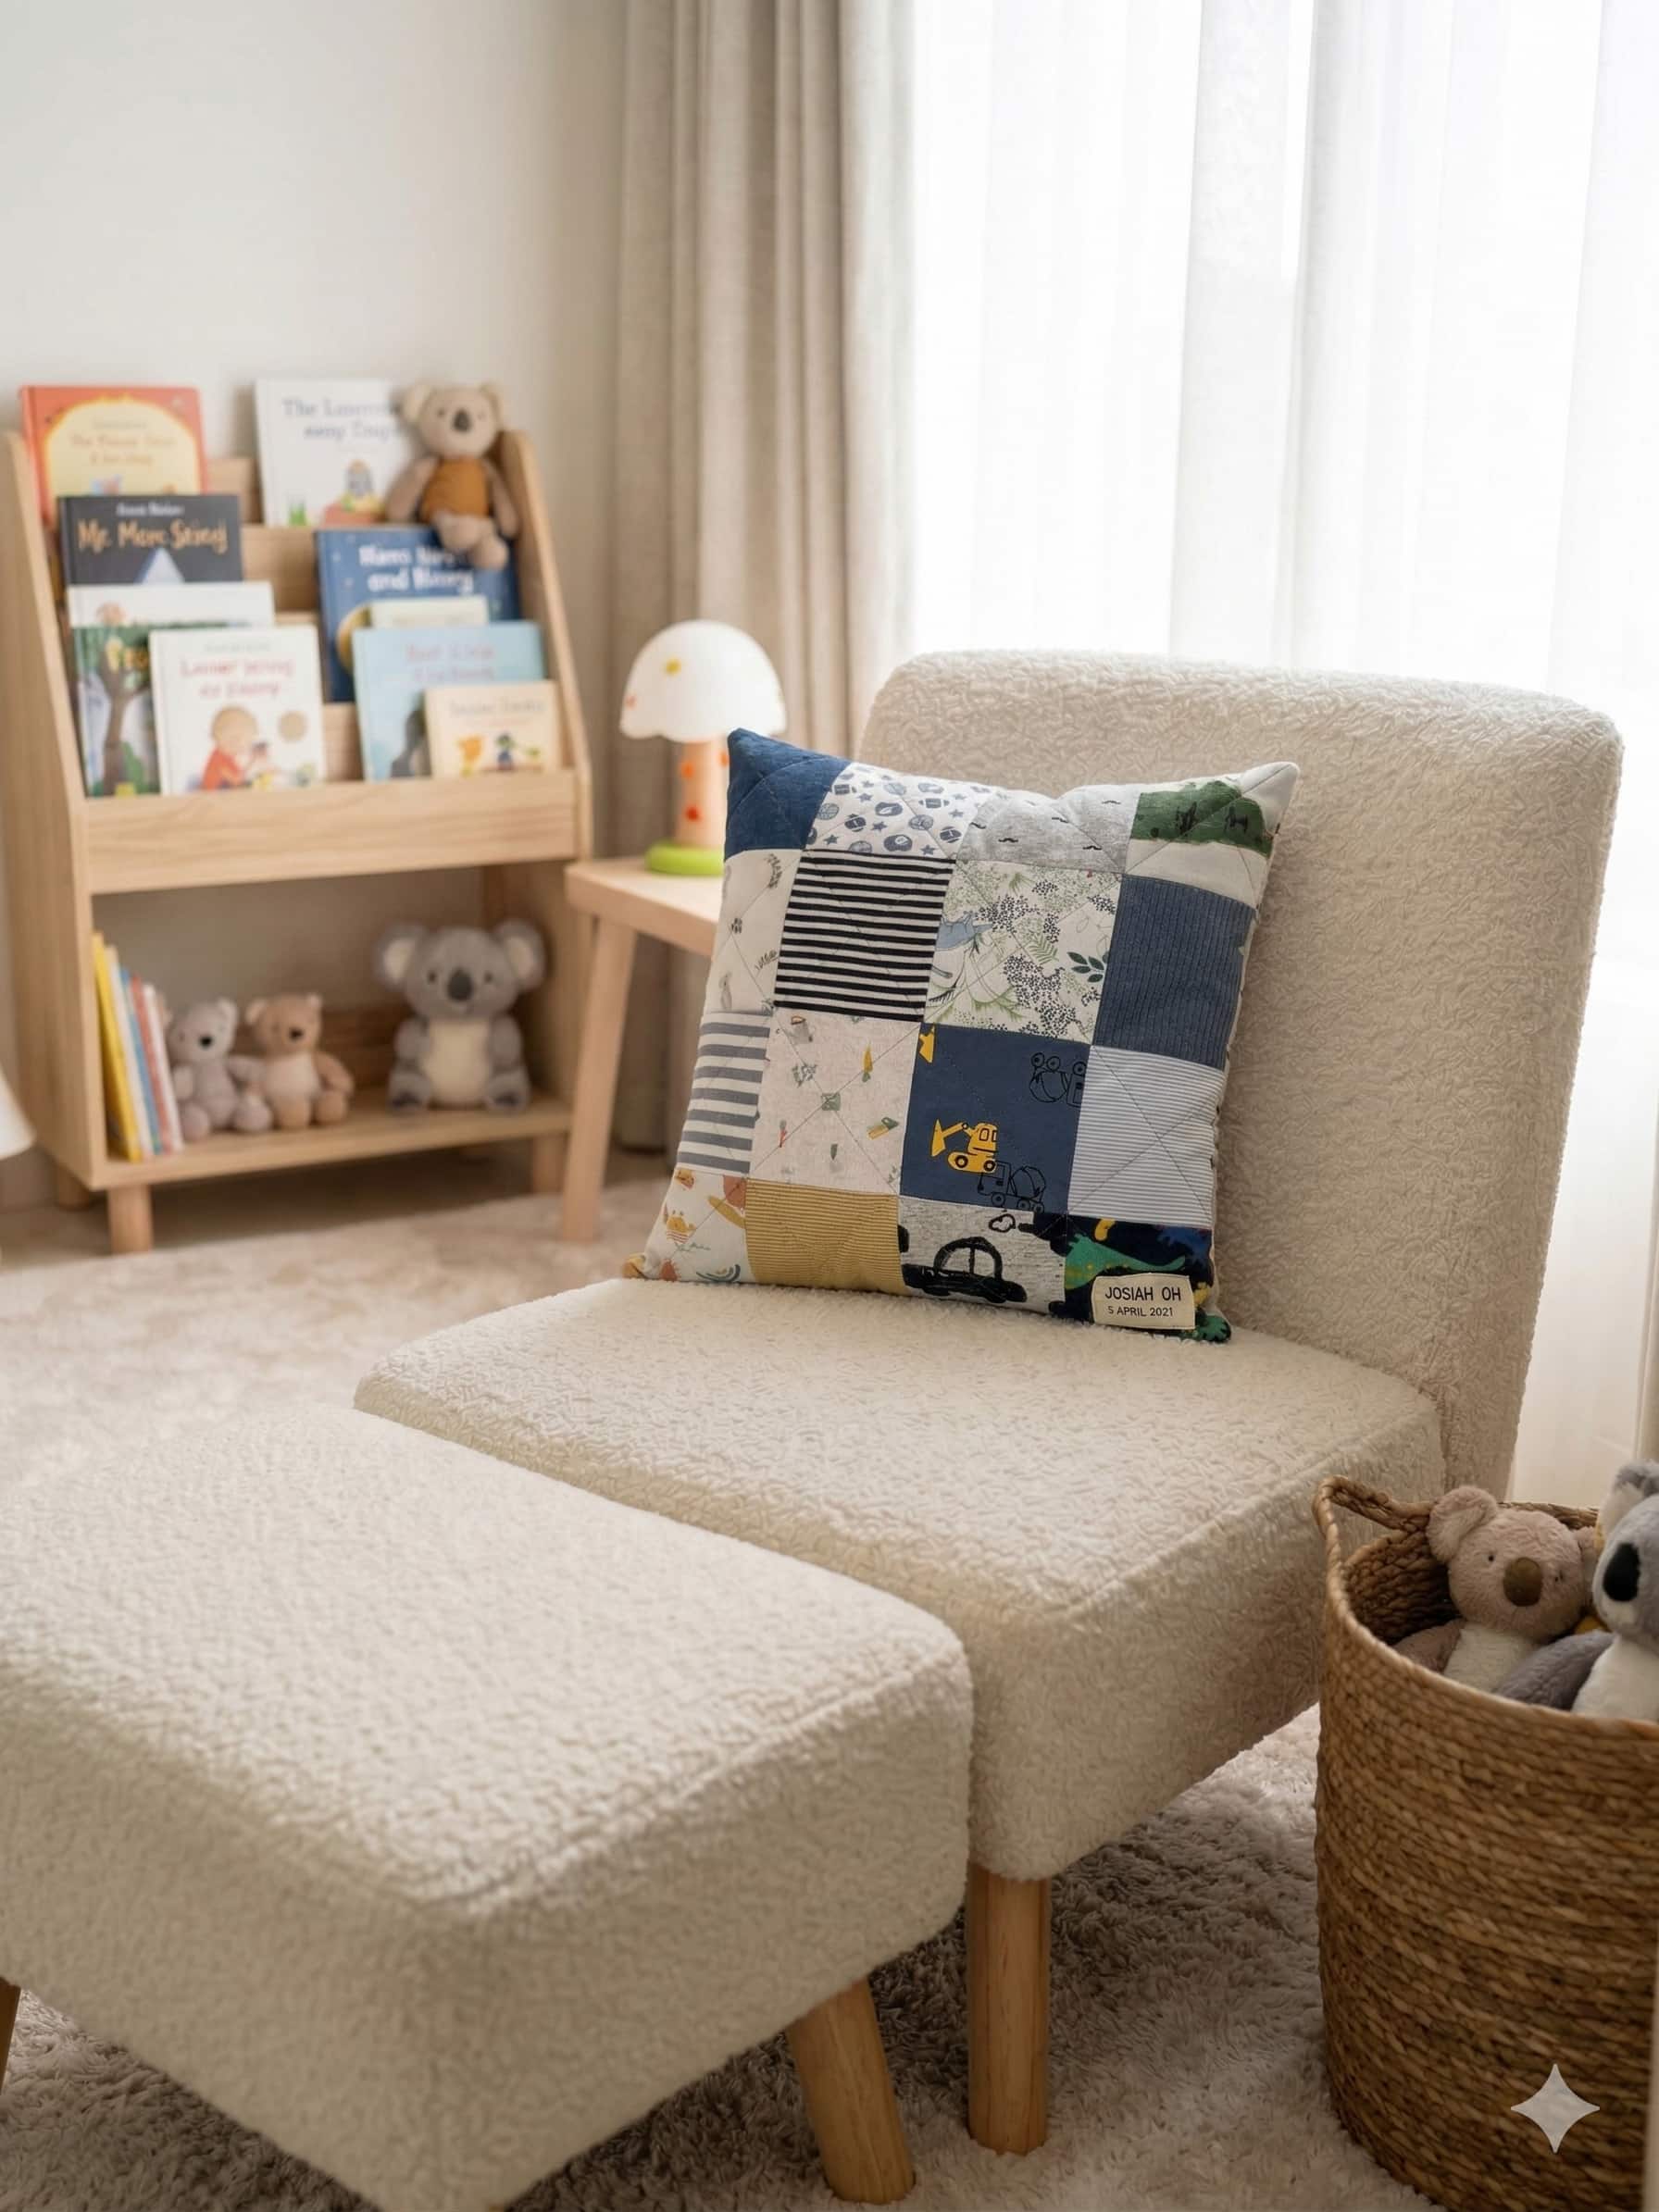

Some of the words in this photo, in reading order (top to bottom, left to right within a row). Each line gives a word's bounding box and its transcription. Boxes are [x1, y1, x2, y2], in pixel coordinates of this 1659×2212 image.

[1104, 1286, 1154, 1301] JOSIAH
[1161, 1286, 1181, 1301] OH
[1108, 1305, 1114, 1314] 5
[1116, 1306, 1147, 1316] APRIL
[1150, 1307, 1173, 1317] 2021
